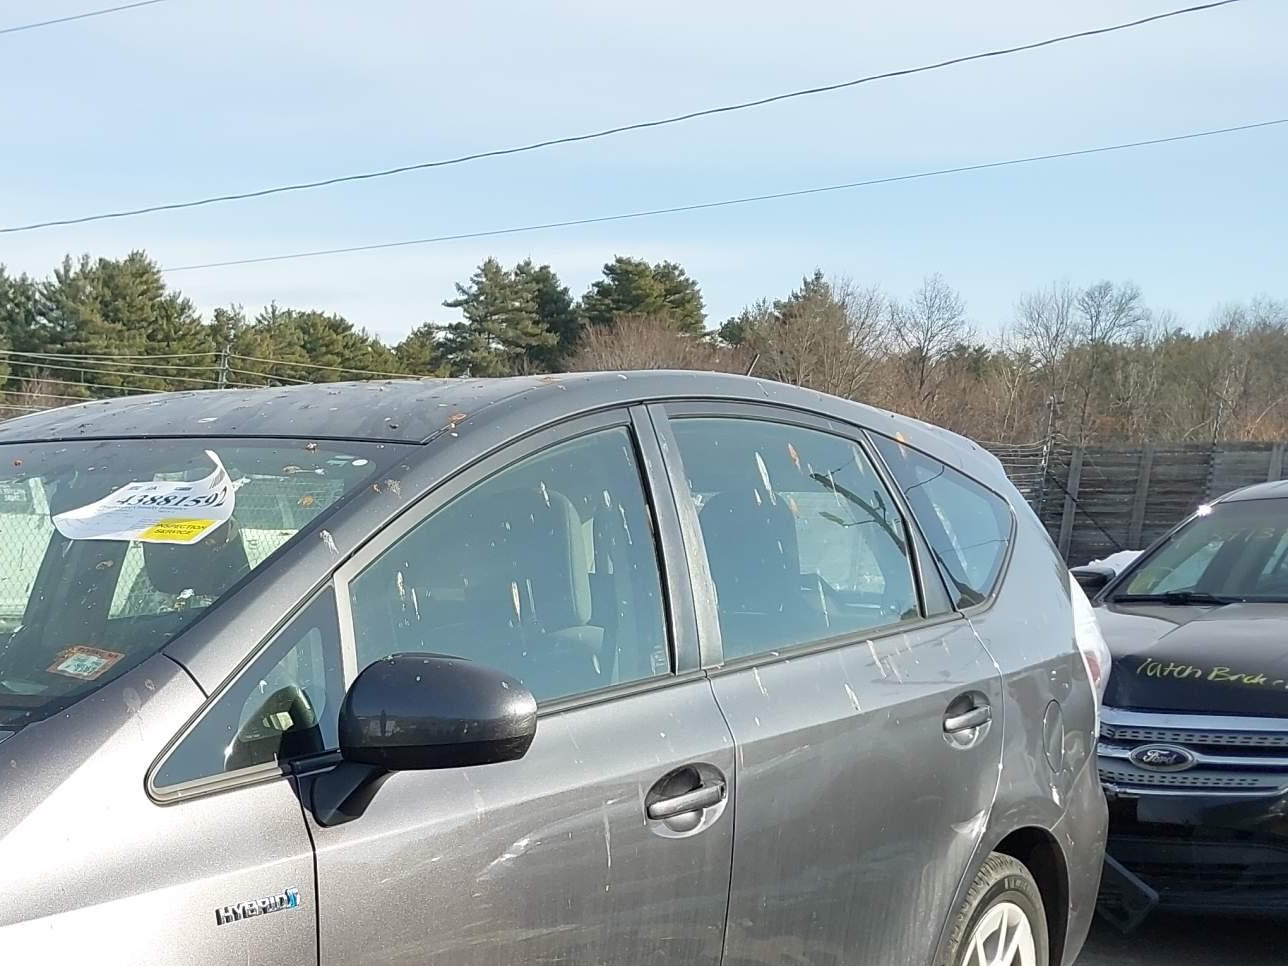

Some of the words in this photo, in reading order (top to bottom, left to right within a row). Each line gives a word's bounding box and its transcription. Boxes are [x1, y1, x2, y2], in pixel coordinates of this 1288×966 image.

[117, 486, 227, 507] 43881592
[1142, 749, 1177, 765] Ford
[215, 895, 289, 926] HYBRID
